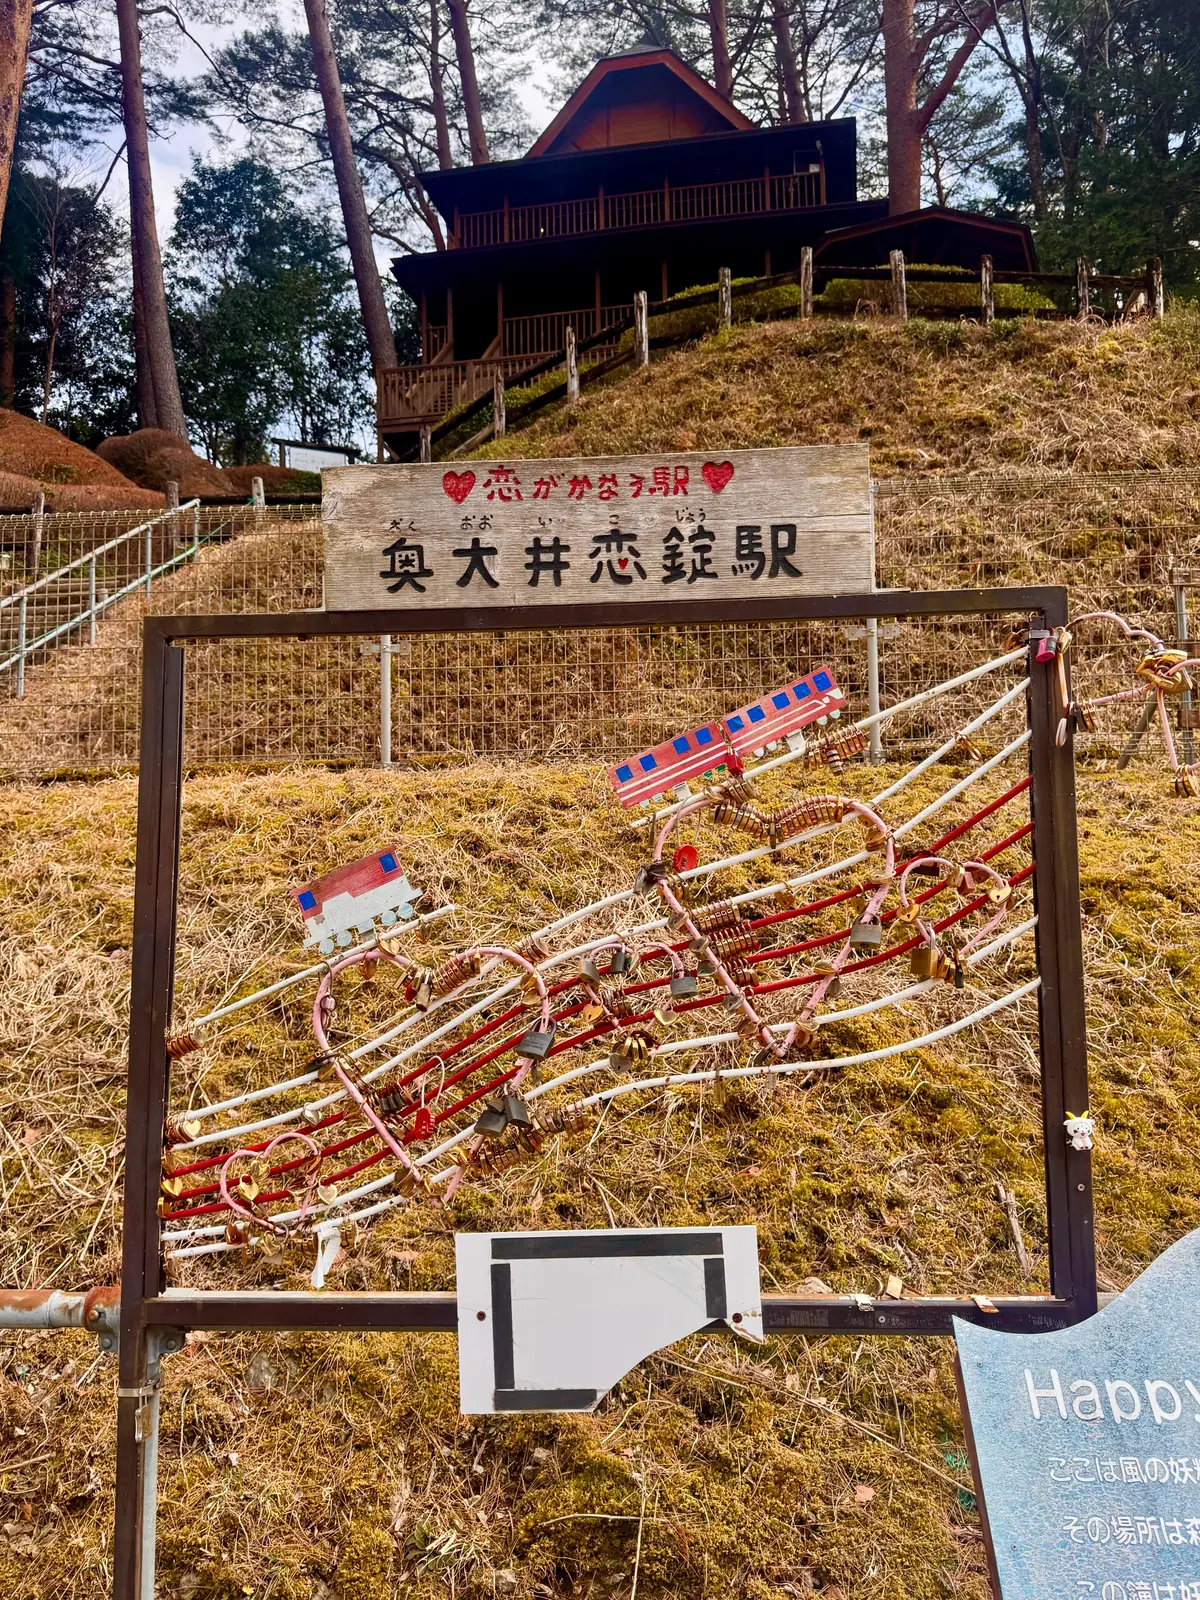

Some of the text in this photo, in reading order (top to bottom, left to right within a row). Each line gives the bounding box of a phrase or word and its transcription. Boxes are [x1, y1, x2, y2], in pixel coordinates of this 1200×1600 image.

[483, 465, 689, 502] 恋がかなう駅
[460, 514, 494, 530] おお
[676, 506, 706, 524] じょう
[379, 524, 803, 593] 奥大井恋錠駅
